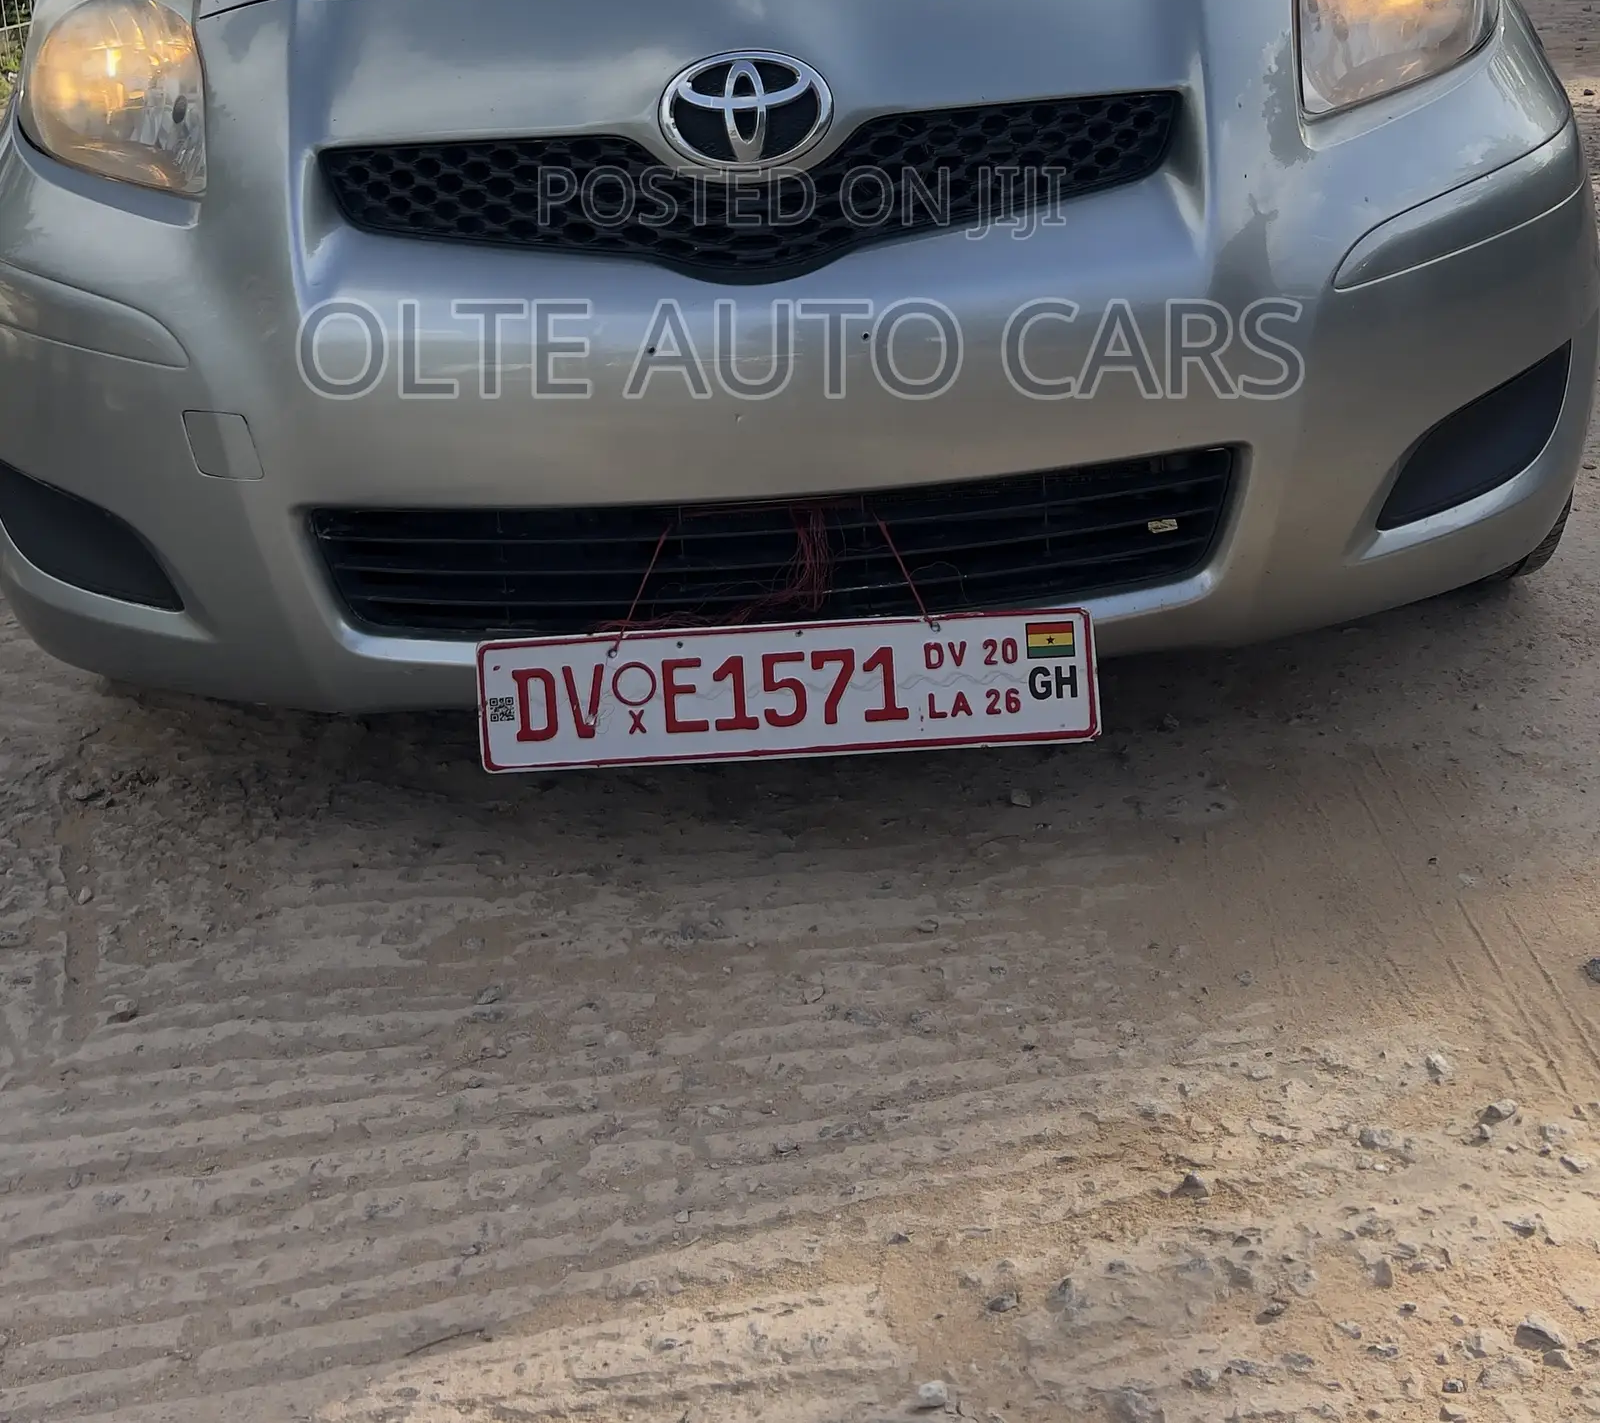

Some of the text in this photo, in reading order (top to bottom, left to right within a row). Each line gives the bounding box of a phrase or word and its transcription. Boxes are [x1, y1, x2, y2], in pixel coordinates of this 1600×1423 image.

[923, 638, 1018, 669] DV 20
[512, 646, 909, 742] DV E1571
[1028, 665, 1078, 700] GH
[928, 688, 1021, 719] LA 26
